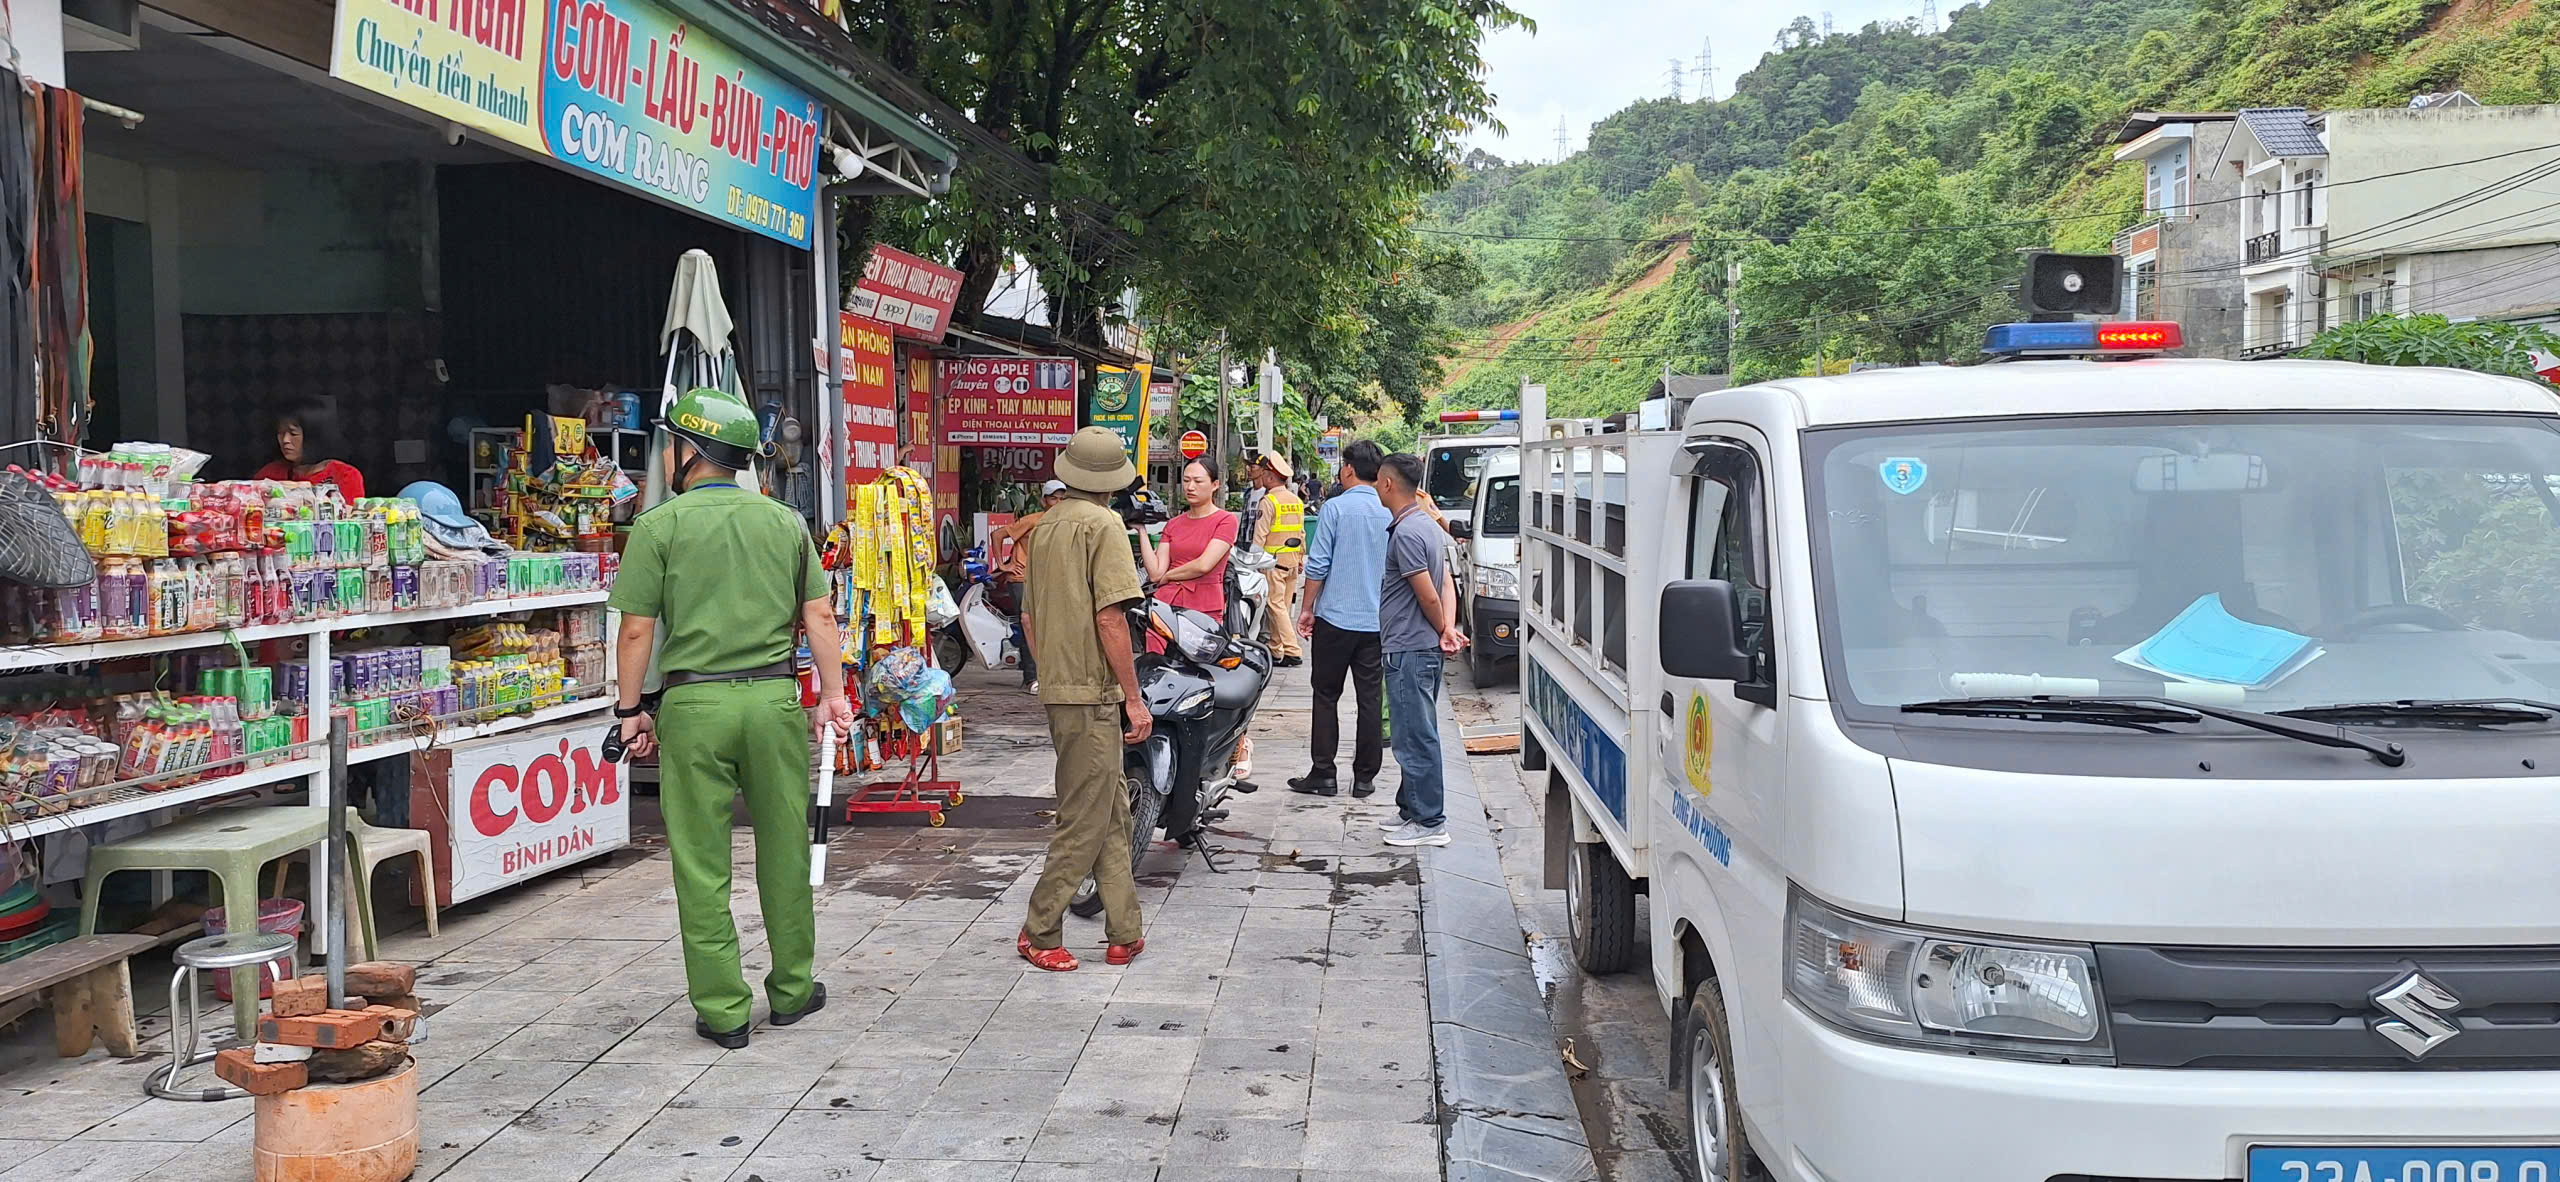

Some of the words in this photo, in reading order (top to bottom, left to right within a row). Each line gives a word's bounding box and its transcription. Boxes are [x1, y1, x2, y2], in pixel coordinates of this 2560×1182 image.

[356, 18, 431, 89] Chuyển
[438, 50, 471, 105] tiền
[476, 73, 529, 127] nhanh
[561, 103, 630, 174] CƠM
[633, 131, 709, 203] RANG
[744, 192, 769, 228] 0979
[770, 201, 787, 234] 771
[788, 208, 805, 241] 360
[928, 272, 957, 303] APPLE
[840, 319, 855, 348] ĂN
[857, 327, 891, 356] PHÒNG
[911, 358, 929, 394] SIM
[991, 363, 1030, 376] APPLE
[948, 395, 961, 414] ÉP
[964, 395, 987, 415] KÍNH
[997, 399, 1020, 415] THAY
[1022, 396, 1045, 416] MÀN
[1048, 396, 1072, 417] HÌNH
[680, 413, 722, 436] CSTT
[962, 419, 983, 430] ĐIỆN
[985, 420, 1012, 431] THOẠI
[1015, 418, 1031, 429] LẤY
[1033, 422, 1059, 430] NGAY
[1120, 434, 1133, 446] ÁY
[469, 737, 620, 837] CƠM
[1672, 787, 1690, 828] CÔNG
[1689, 807, 1701, 839] AN
[503, 841, 552, 875] BÌNH
[557, 825, 594, 857] DÂN
